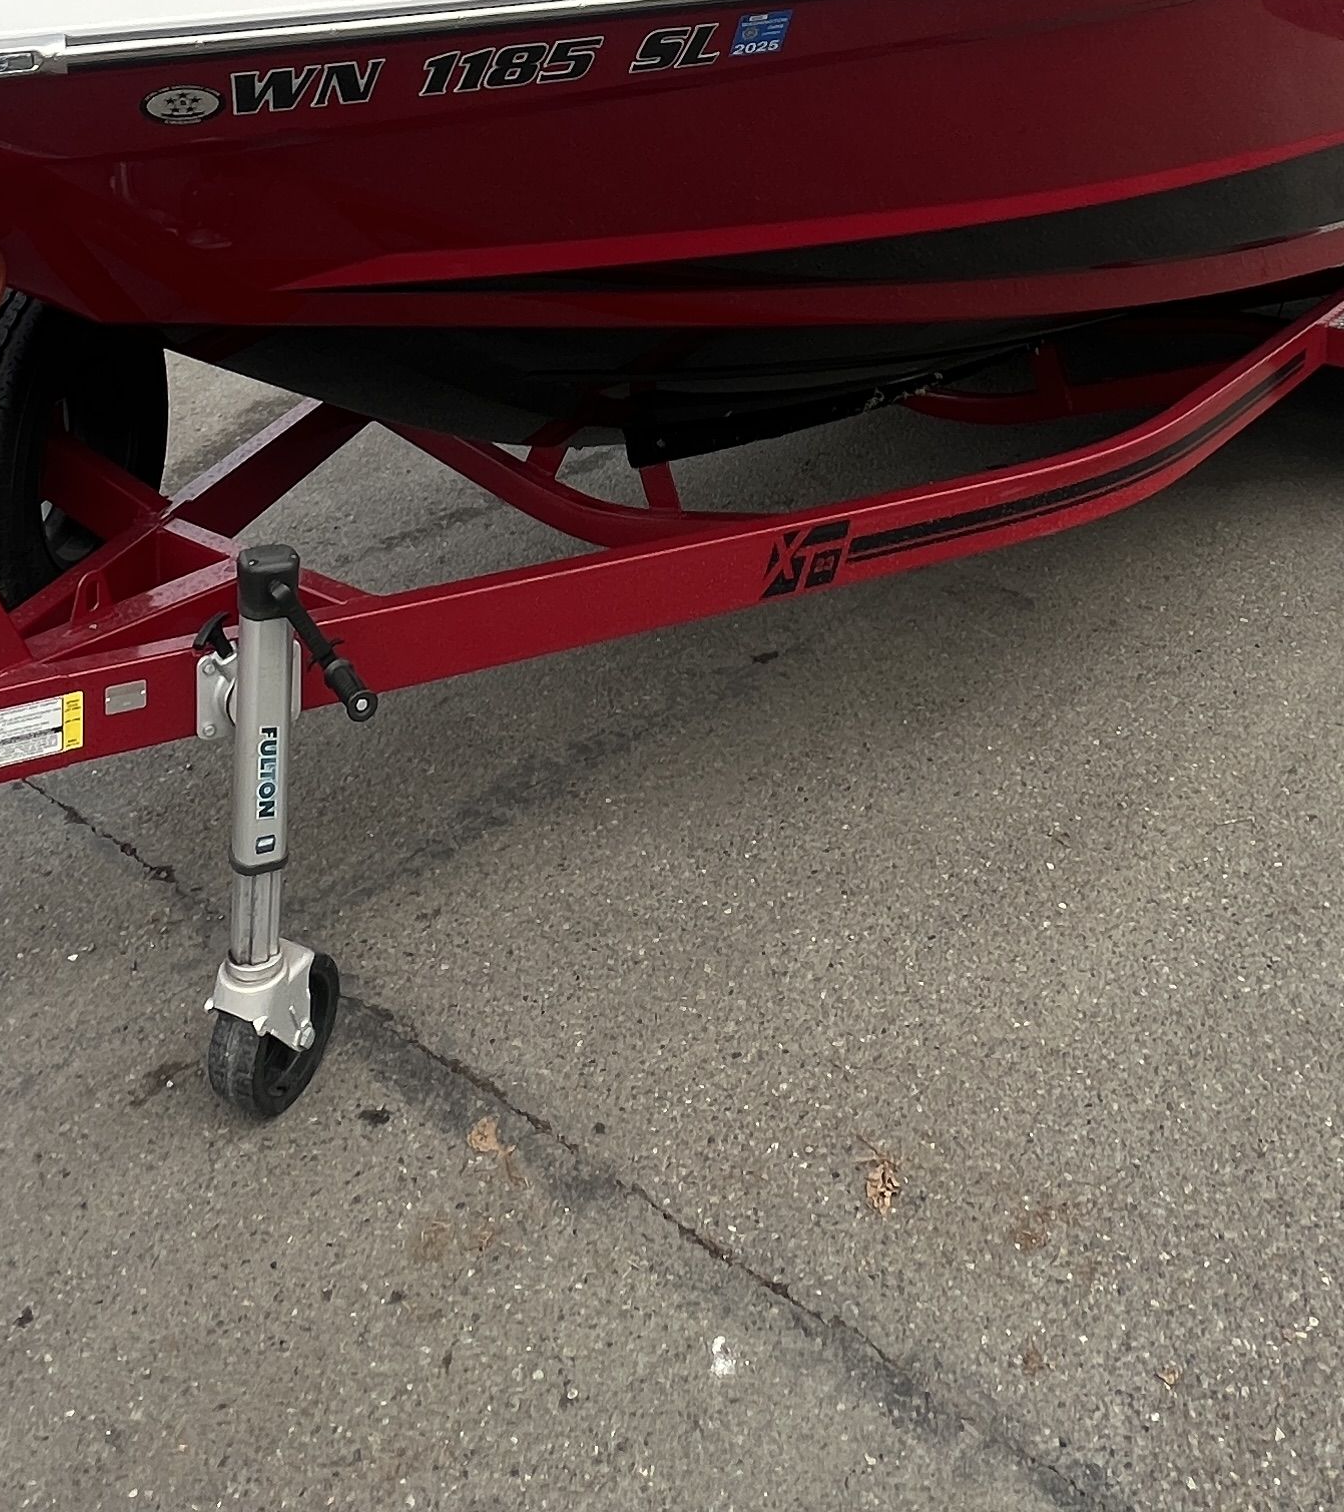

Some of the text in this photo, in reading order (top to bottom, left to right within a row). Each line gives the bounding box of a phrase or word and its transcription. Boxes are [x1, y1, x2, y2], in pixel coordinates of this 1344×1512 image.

[230, 58, 386, 116] WN
[418, 35, 605, 97] 1185
[628, 22, 720, 74] SL
[732, 39, 781, 56] 2025
[256, 725, 280, 820] FULTON
